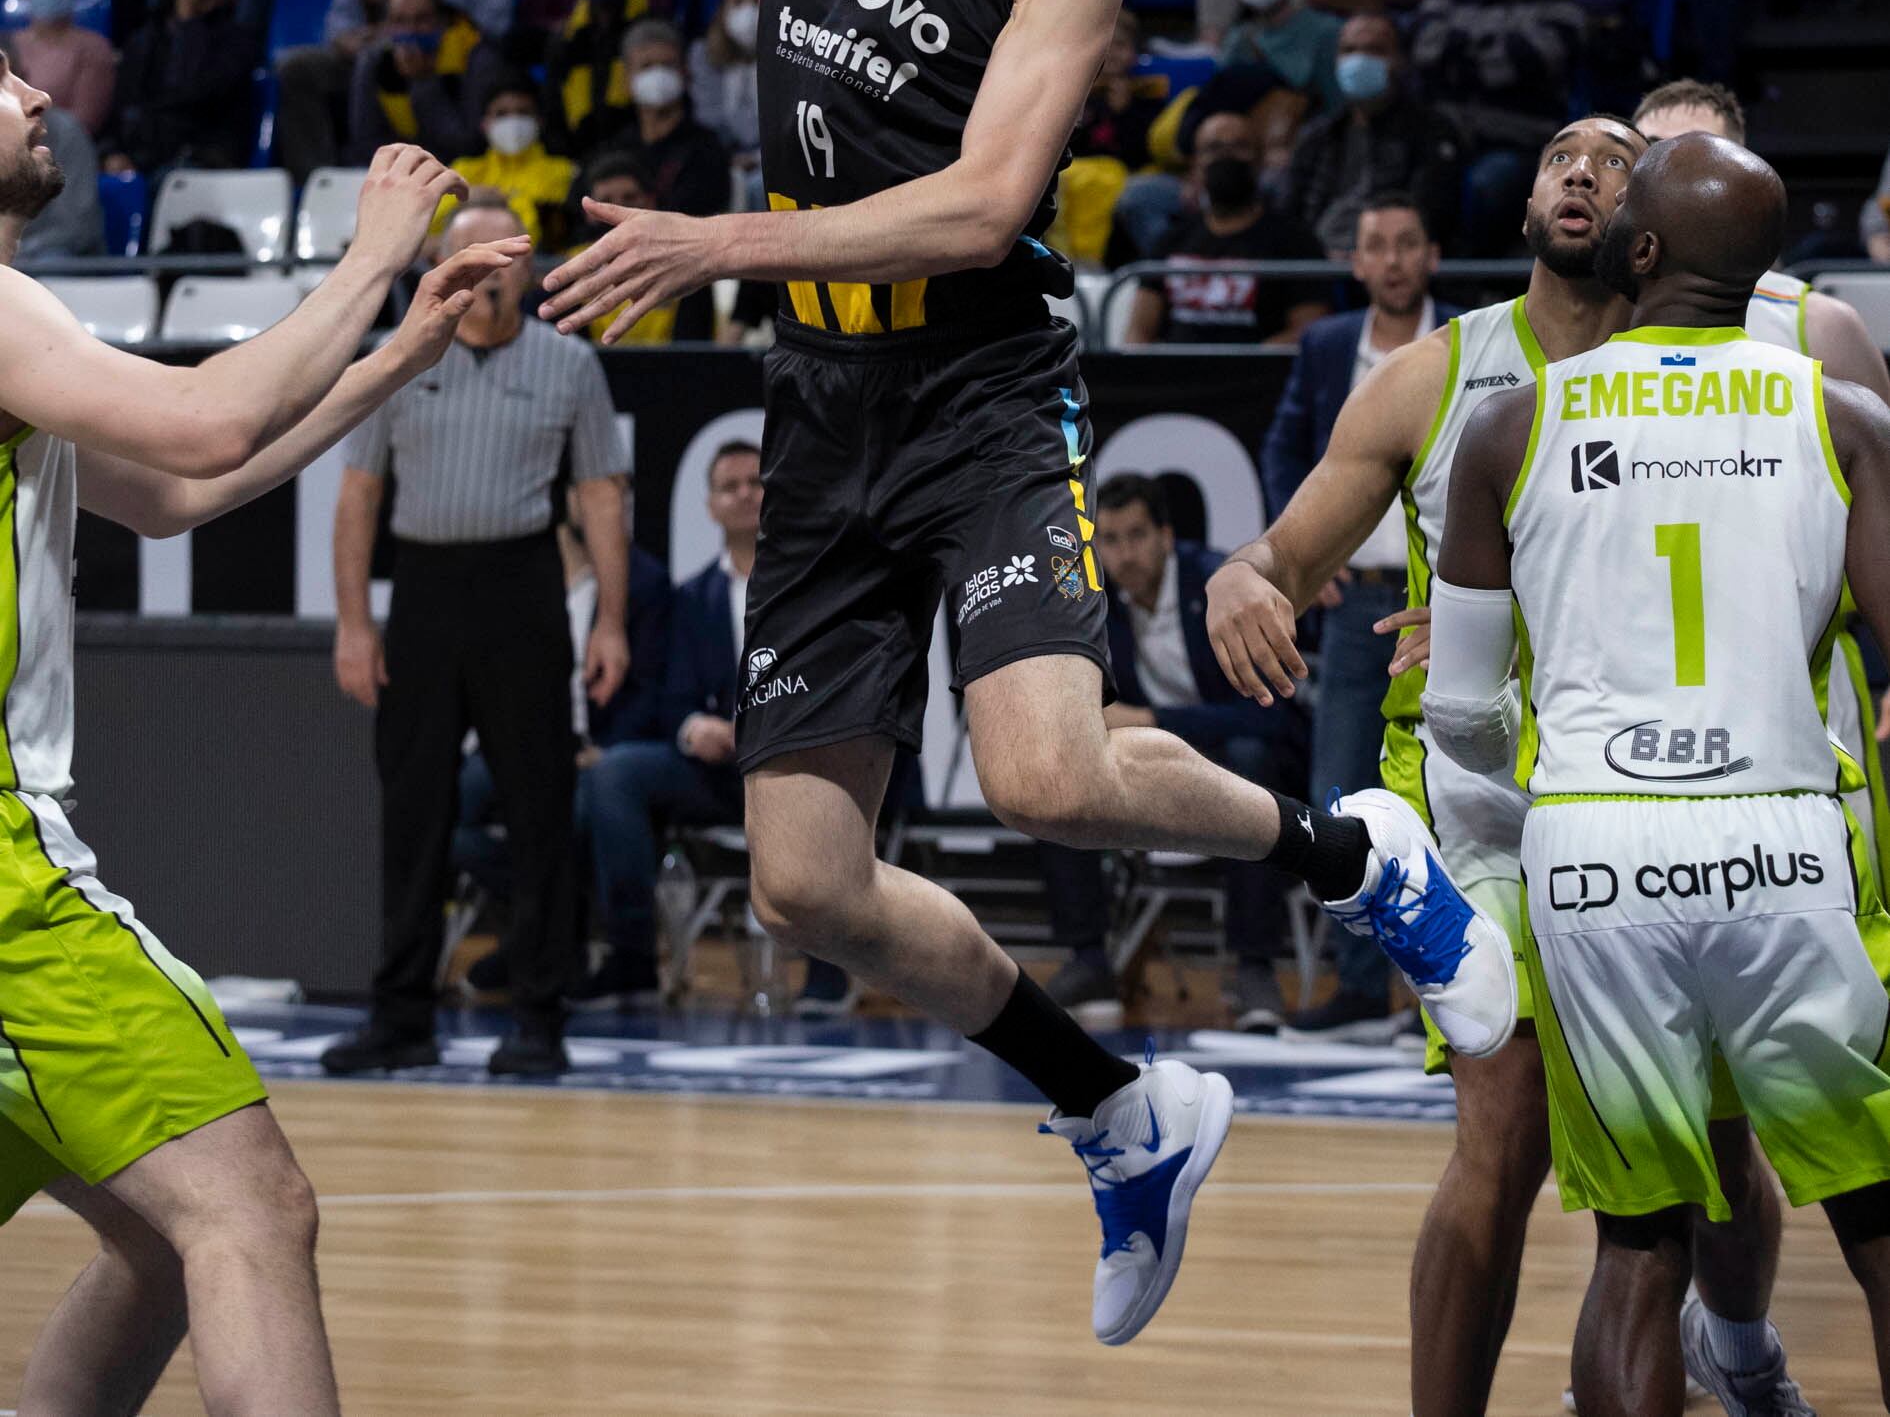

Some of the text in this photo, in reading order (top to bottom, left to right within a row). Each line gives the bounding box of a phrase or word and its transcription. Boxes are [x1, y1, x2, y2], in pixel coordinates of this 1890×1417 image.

[796, 99, 835, 179] 19
[1561, 369, 1793, 421] EMEGANO
[1052, 534, 1072, 547] acb
[958, 580, 1001, 624] anarias
[965, 565, 999, 596] Islas
[1655, 523, 1705, 687] 1
[1635, 843, 1825, 913] carplus
